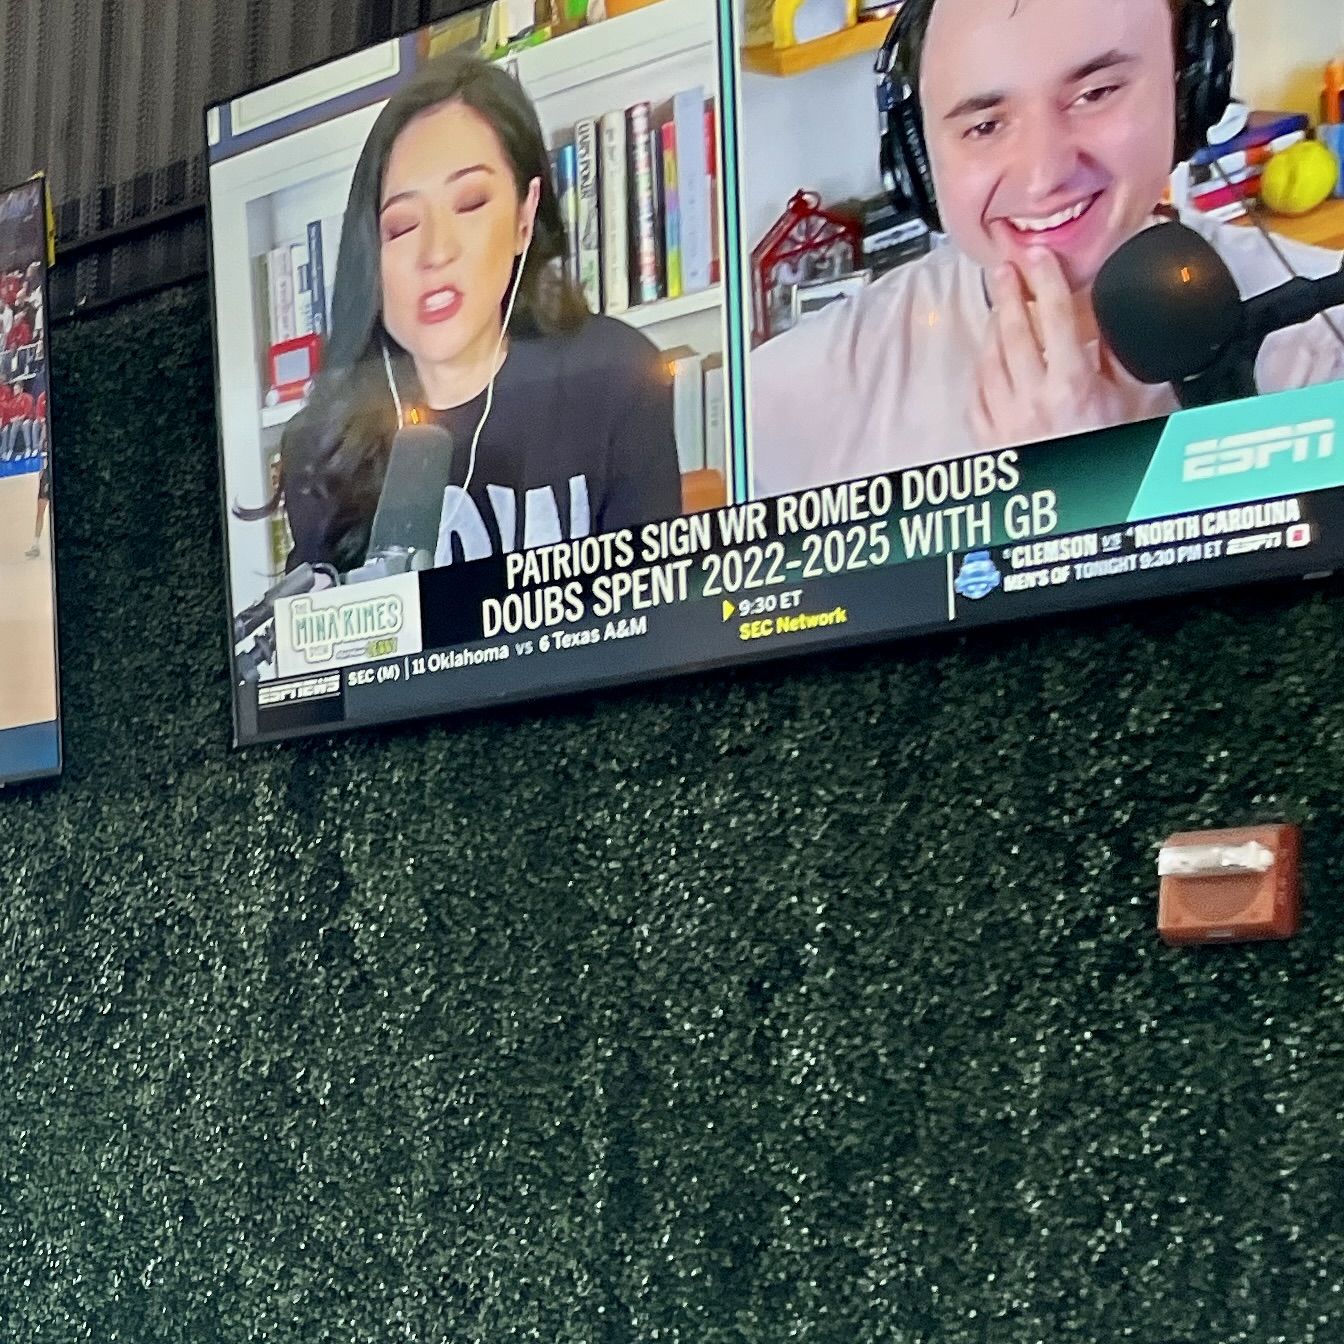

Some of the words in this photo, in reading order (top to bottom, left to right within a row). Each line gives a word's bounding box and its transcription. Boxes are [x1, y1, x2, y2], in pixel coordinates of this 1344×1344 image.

[1182, 418, 1335, 483] ESPN
[506, 530, 632, 590] PATRIOTS
[641, 513, 711, 561] SIGN
[718, 502, 768, 546] WR
[777, 476, 892, 524] ROMEO
[902, 450, 1020, 506] DOUBS
[1011, 533, 1098, 569] CLEMSON
[1134, 515, 1201, 548] NORTH
[1202, 499, 1301, 536] CAROLINA
[482, 587, 586, 639] DOUBS
[591, 559, 695, 616] SPENT
[701, 527, 889, 598] 2022-2025
[901, 502, 991, 561] WITH
[1003, 490, 1058, 539] GB
[295, 611, 339, 646] MINA
[343, 599, 398, 637] KIMES
[739, 595, 778, 617] 9:30
[780, 589, 803, 609] ET
[739, 619, 774, 641] SEC
[777, 607, 847, 633] Network
[348, 670, 375, 686] SEC
[377, 666, 400, 683] (M)
[412, 659, 426, 675] 11
[428, 644, 510, 672] Oklahoma
[515, 639, 534, 655] vs
[538, 635, 550, 652] 6
[551, 627, 601, 650] Texas
[603, 615, 648, 641] A&M
